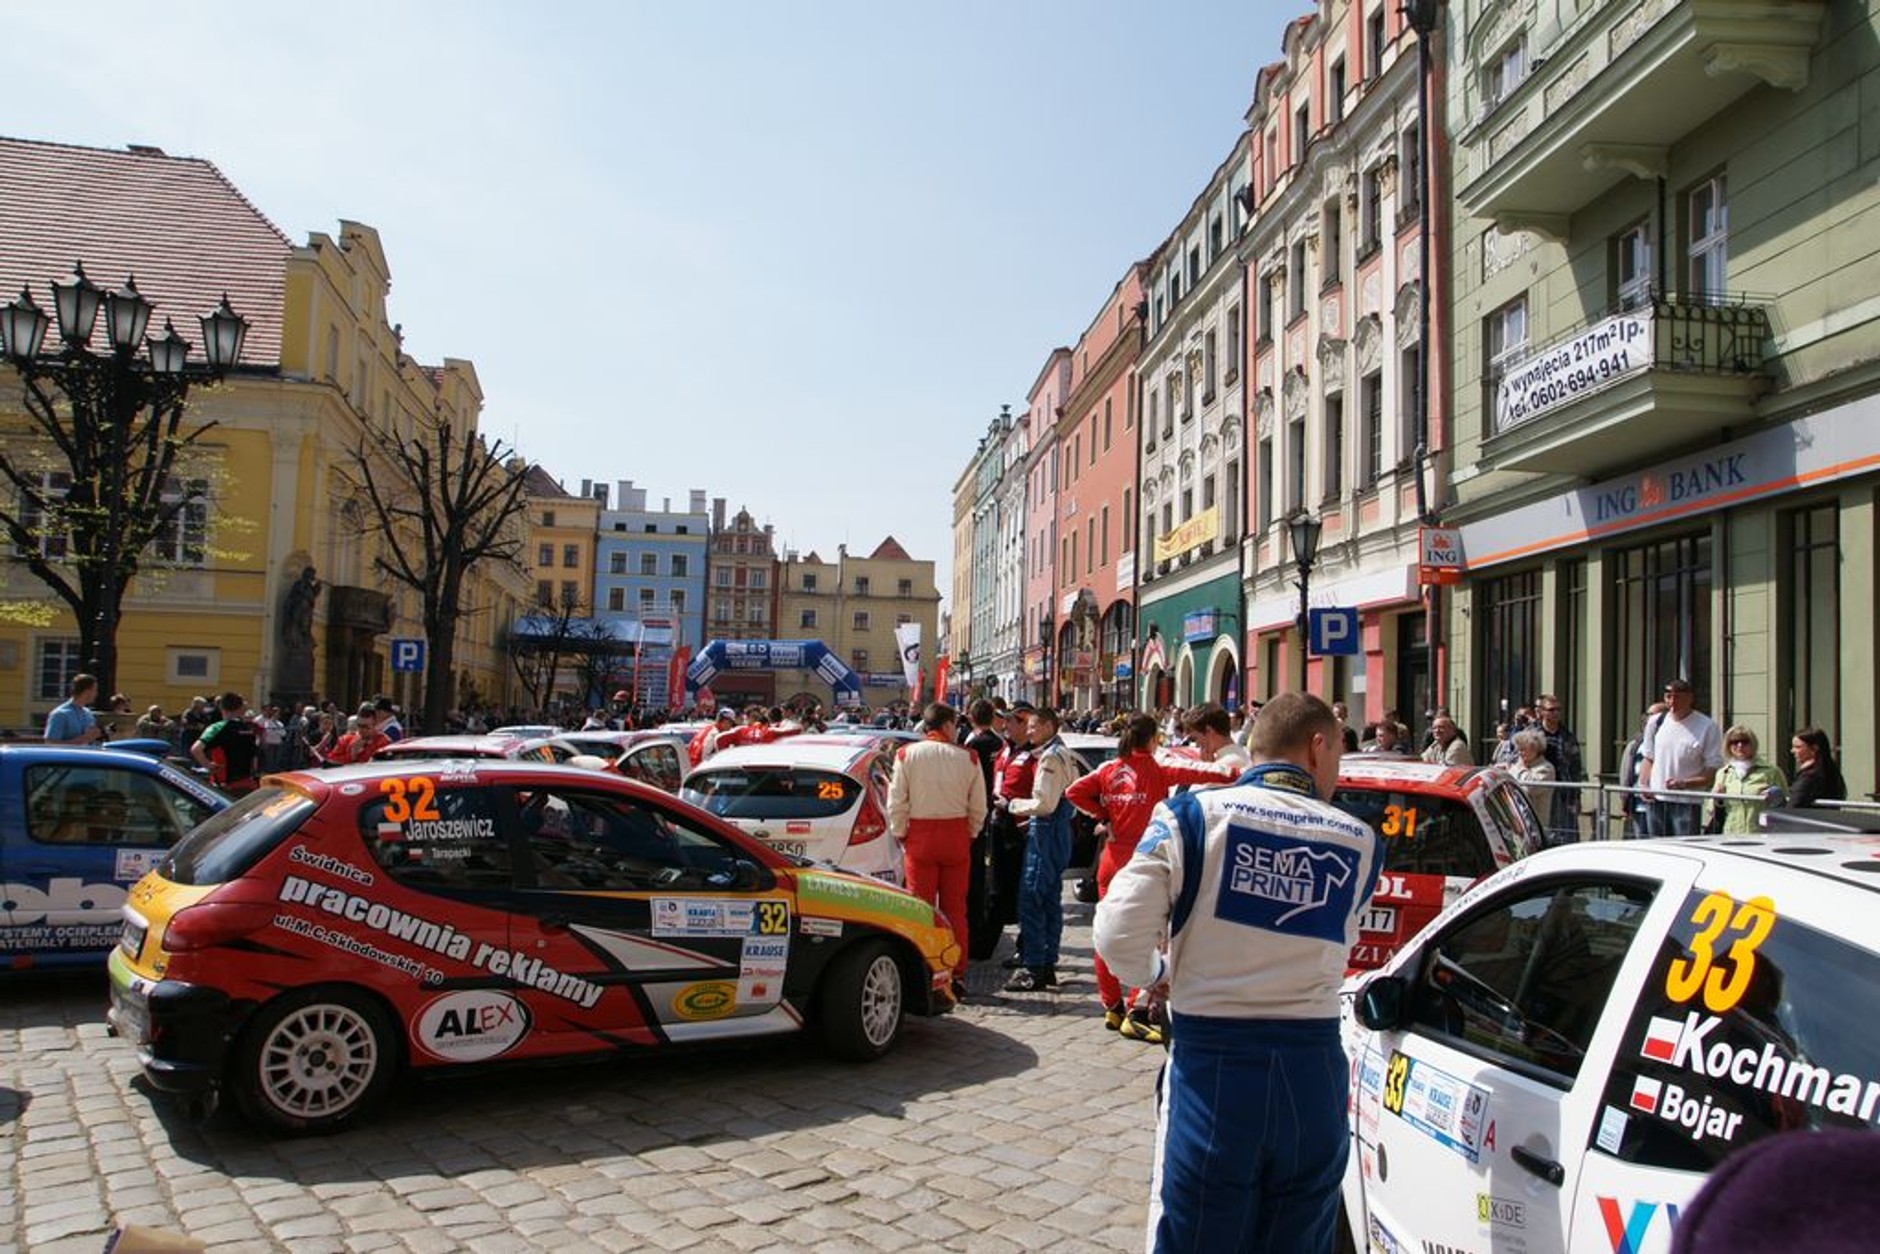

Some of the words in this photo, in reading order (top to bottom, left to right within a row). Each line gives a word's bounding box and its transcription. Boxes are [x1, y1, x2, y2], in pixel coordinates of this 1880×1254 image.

[1597, 486, 1636, 520] ING
[1670, 453, 1746, 501] BANK
[1427, 551, 1456, 562] ING
[1321, 613, 1348, 649] P
[399, 642, 417, 667] P
[380, 777, 440, 822] 32
[818, 782, 844, 799] 25
[405, 813, 495, 841] Jaroszewicz
[1382, 805, 1417, 837] 31
[289, 845, 374, 886] Świdnica
[1235, 843, 1314, 879] SEMA
[1232, 868, 1313, 904] PRINT
[759, 903, 787, 933] 32
[278, 876, 472, 961] pracownia
[471, 942, 605, 1009] reklamy
[745, 945, 784, 957] KRAUSE
[1666, 890, 1776, 1012] 33
[423, 968, 444, 986] 10
[435, 1001, 514, 1038] ALEX
[1385, 1054, 1408, 1113] 33
[1660, 1084, 1743, 1141] Bojar
